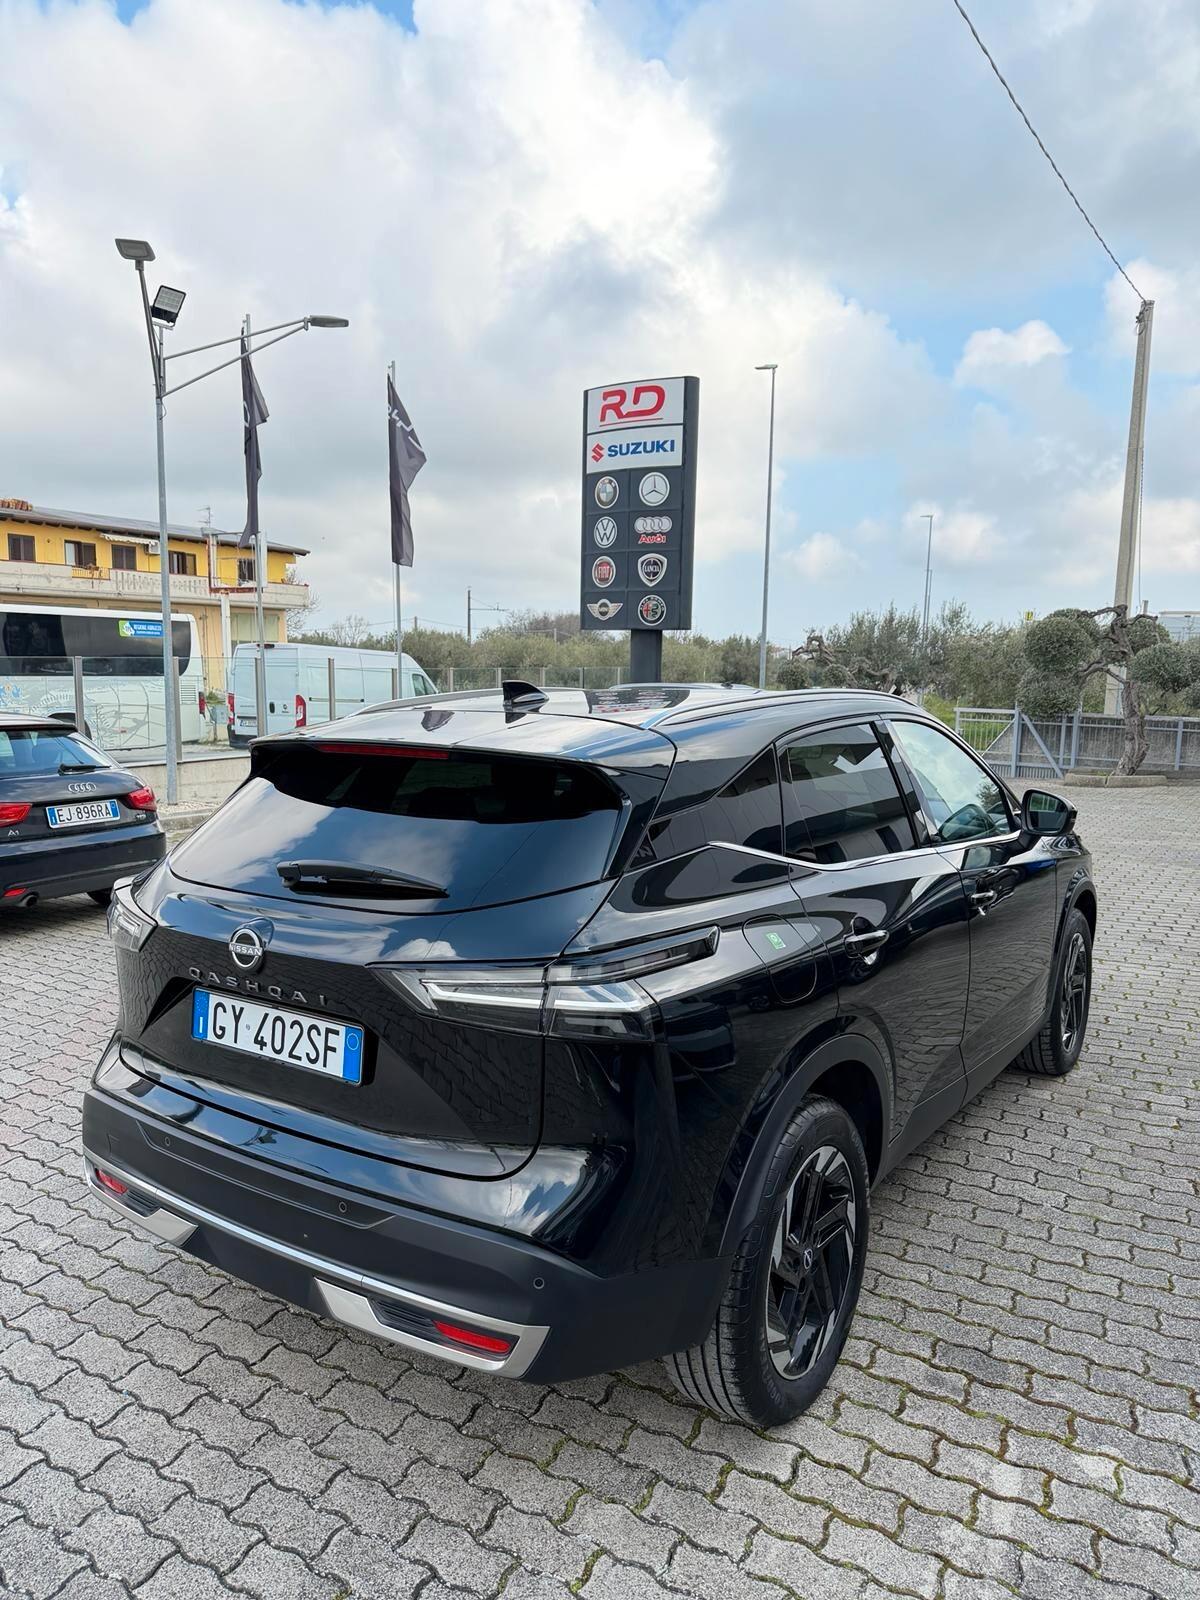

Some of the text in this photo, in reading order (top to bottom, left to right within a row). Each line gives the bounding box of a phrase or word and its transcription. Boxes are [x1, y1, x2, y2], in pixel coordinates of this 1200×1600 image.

[600, 385, 665, 422] RD
[607, 440, 675, 458] SUZUKI
[56, 808, 73, 823] EJ
[76, 804, 112, 820] 896RA
[7, 829, 20, 837] A1
[230, 943, 262, 956] NISSAN
[188, 966, 329, 1007] QASHQAI
[212, 1001, 245, 1044] GY
[253, 1012, 340, 1068] 402SF
